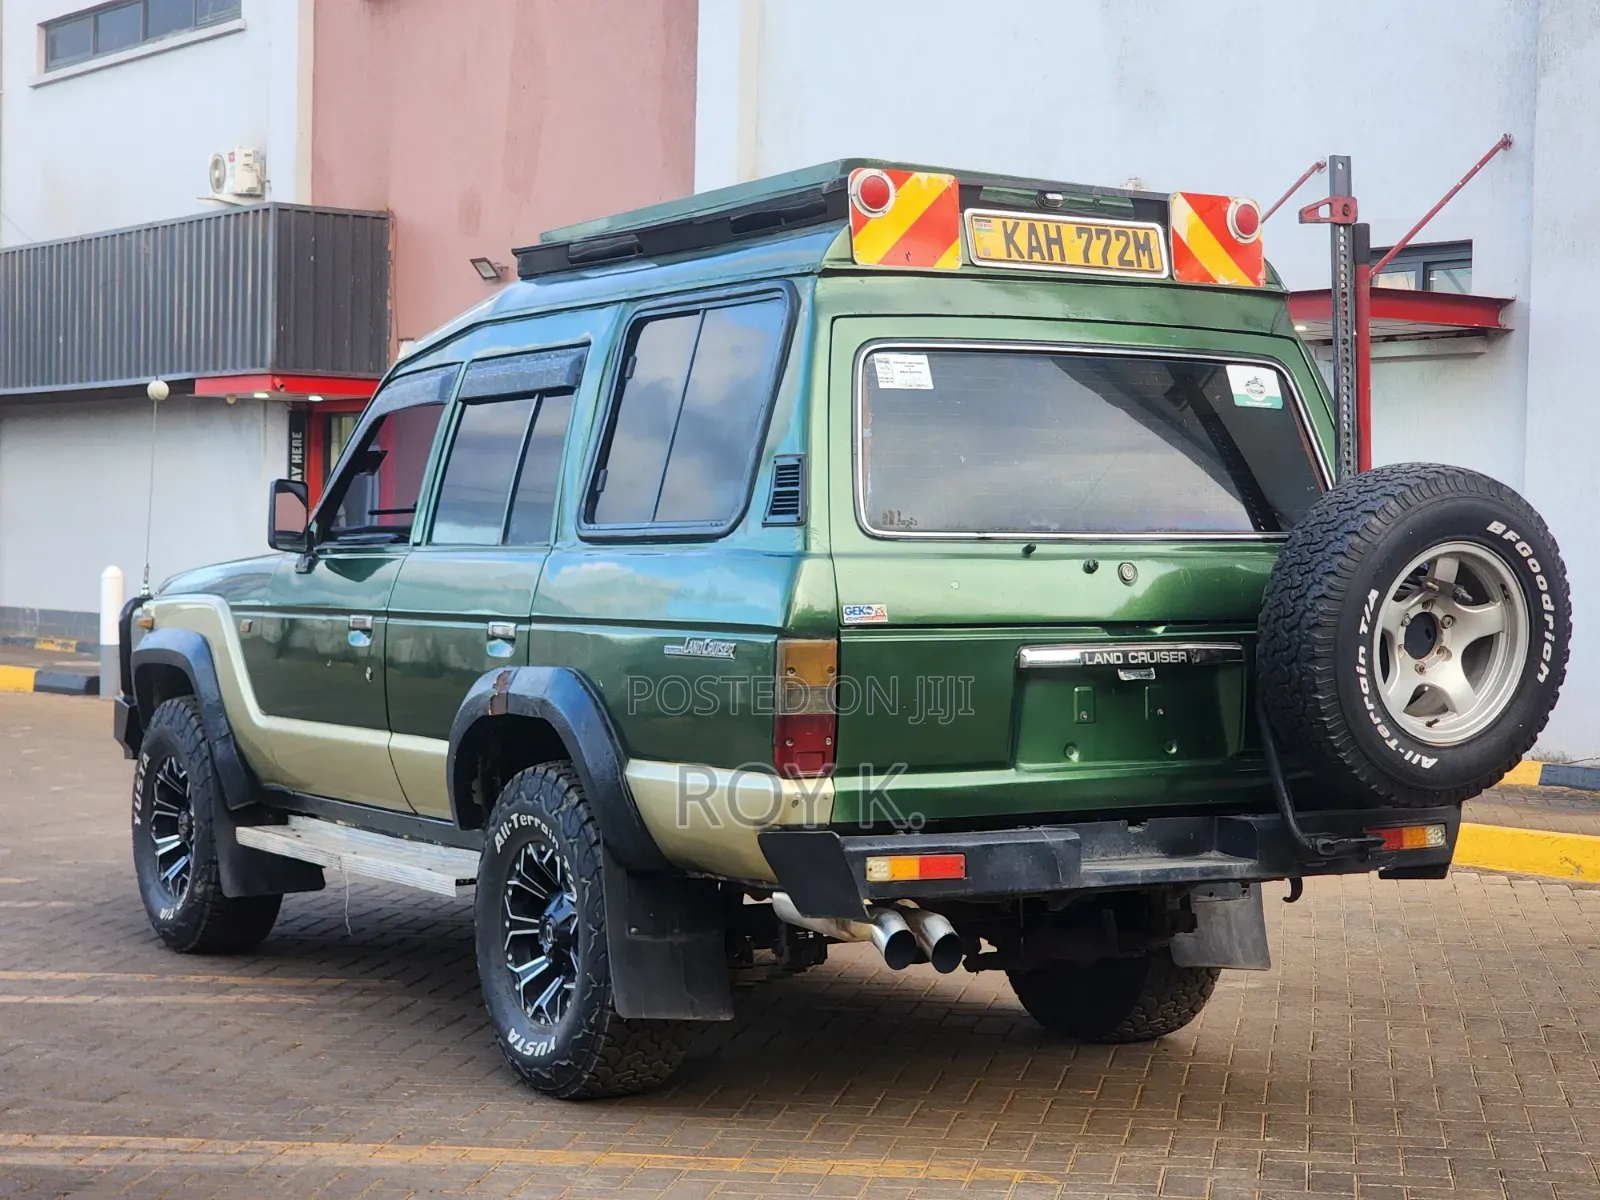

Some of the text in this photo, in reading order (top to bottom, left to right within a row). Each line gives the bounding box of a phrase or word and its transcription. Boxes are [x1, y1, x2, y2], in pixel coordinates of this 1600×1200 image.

[1001, 220, 1155, 269] KAH 772M
[291, 431, 303, 481] AY HERE
[1486, 520, 1556, 684] BFGoodrich
[1085, 651, 1188, 665] LAND CRUISER
[1355, 588, 1438, 769] All-Terrain T/A
[134, 752, 150, 826] YUSTA
[494, 812, 559, 854] All-Terrain
[507, 1027, 556, 1057] YUSTA
